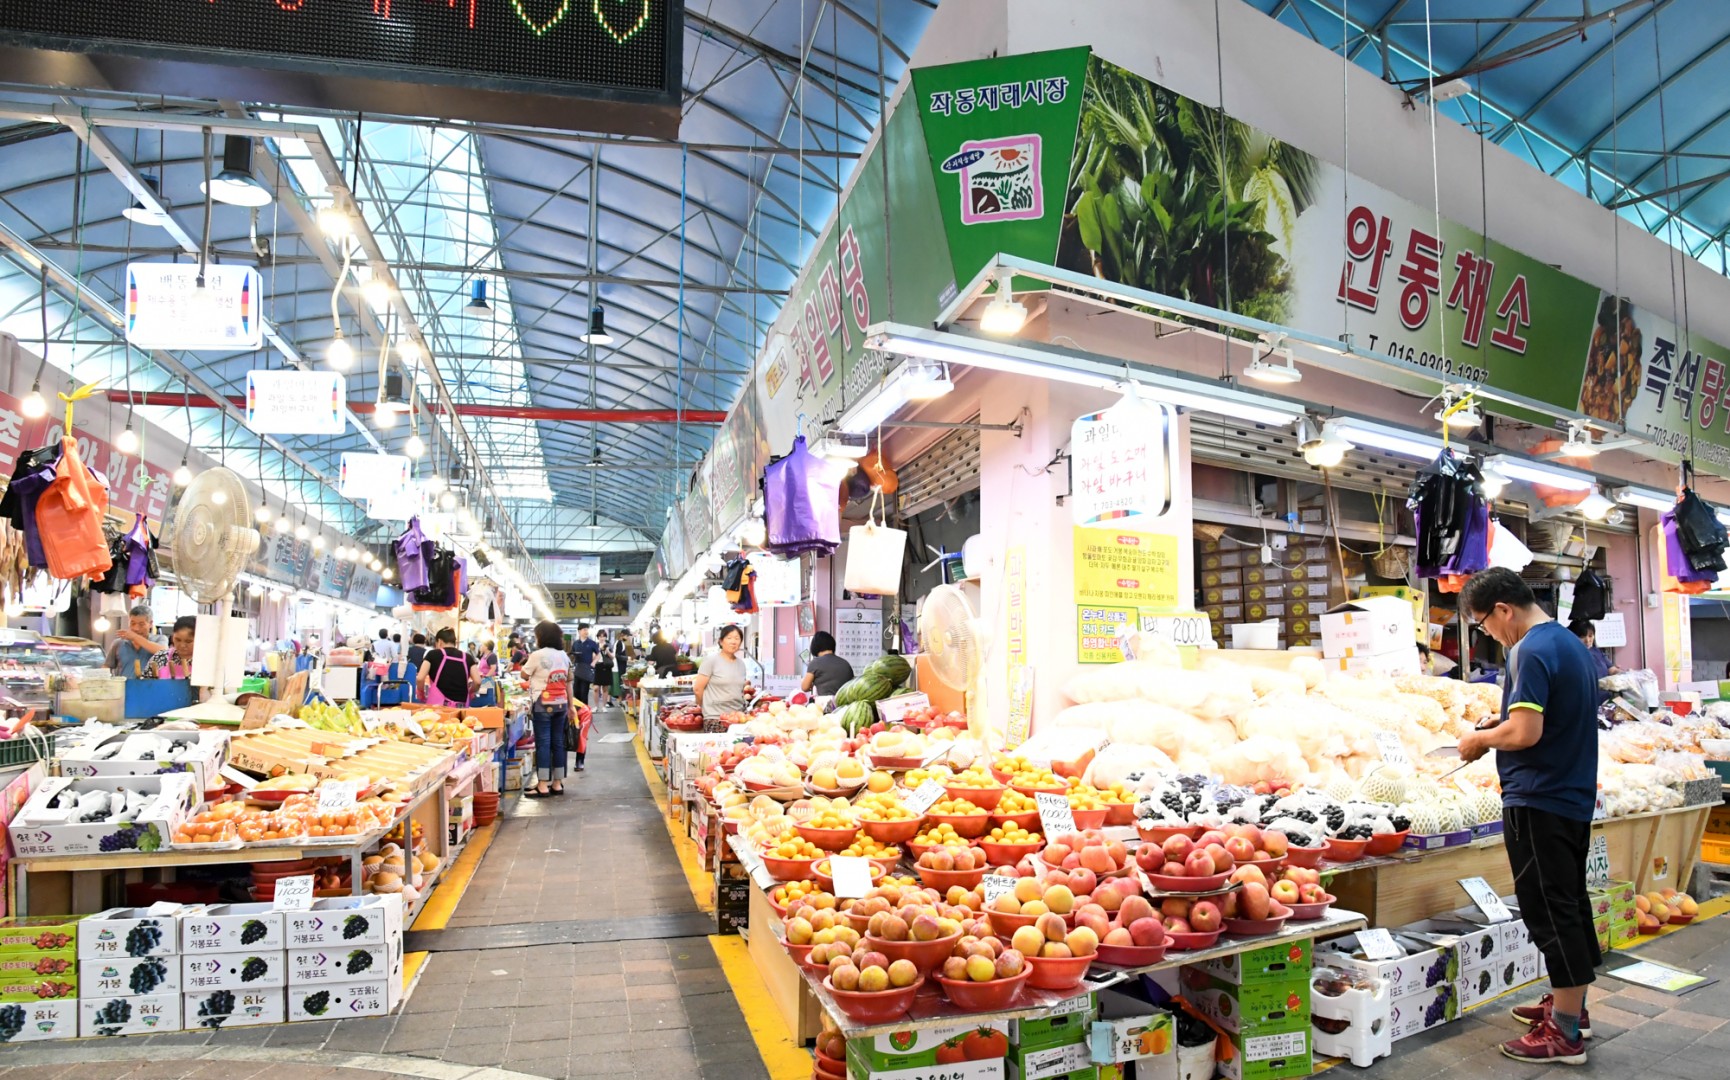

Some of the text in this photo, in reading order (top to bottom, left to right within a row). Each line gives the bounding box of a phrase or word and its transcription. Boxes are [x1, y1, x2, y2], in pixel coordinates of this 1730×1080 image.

[930, 76, 1069, 117] 좌동재래시장
[1336, 204, 1531, 355] 안동채소
[789, 223, 871, 398] 과일마당
[1082, 609, 1106, 622] 온누리
[1082, 624, 1115, 635] 전자 카드
[1173, 617, 1204, 644] 2000
[1082, 638, 1120, 649] 환영합니다
[277, 886, 310, 897] 11000
[190, 939, 222, 949] 거봉포도
[293, 934, 324, 944] 거봉포도
[95, 941, 118, 952] 거봉
[296, 969, 328, 980] 거봉포도
[98, 978, 123, 989] 거봉
[190, 976, 222, 986] 거봉포도
[1121, 1038, 1143, 1055] 살구
